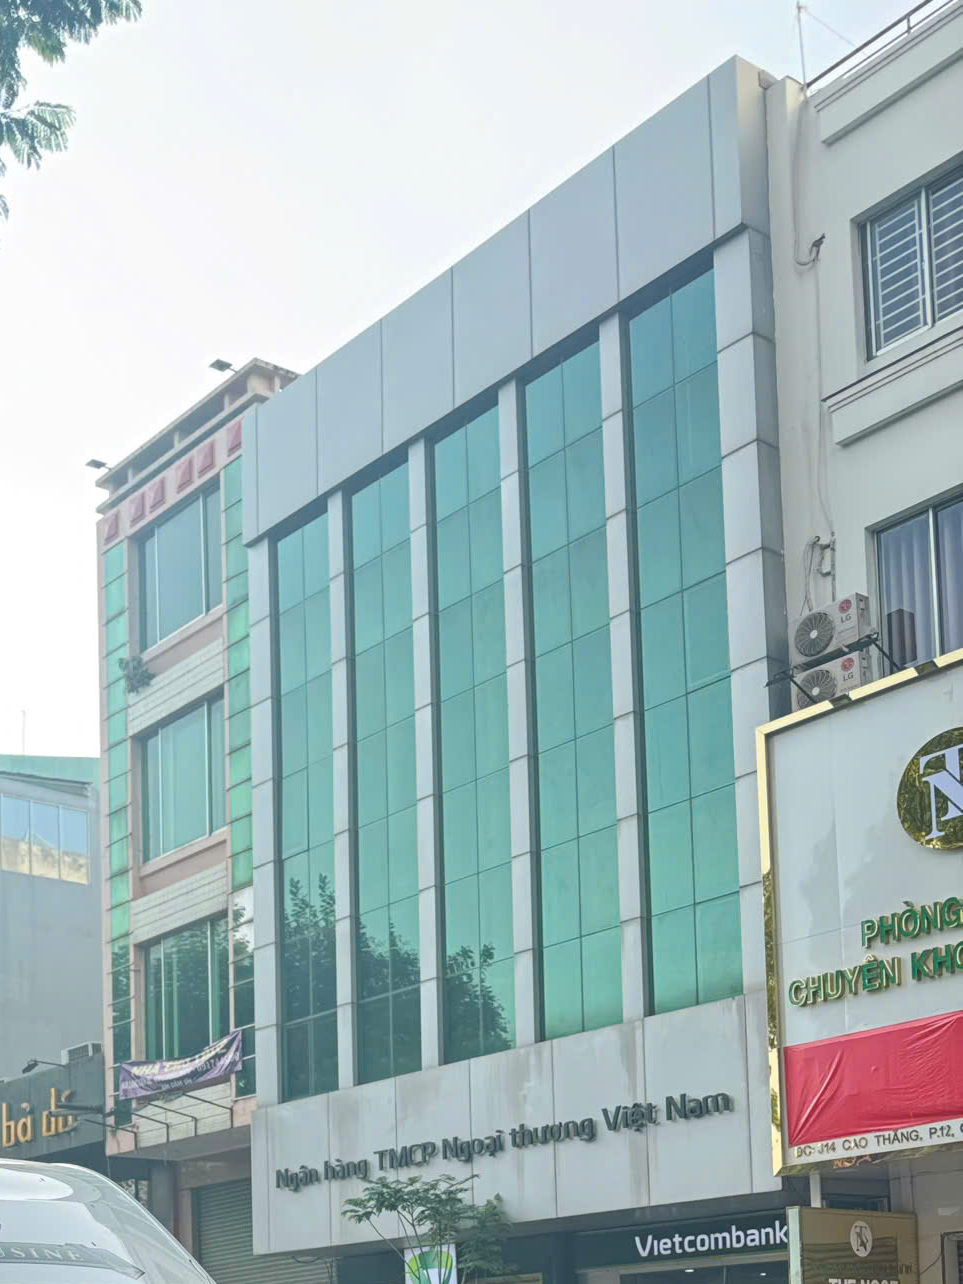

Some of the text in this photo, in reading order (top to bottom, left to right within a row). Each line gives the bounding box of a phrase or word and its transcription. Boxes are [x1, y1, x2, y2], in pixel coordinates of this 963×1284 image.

[841, 613, 852, 624] LG
[843, 671, 854, 682] LG
[861, 896, 963, 948] PHÒNG
[788, 953, 902, 1007] CHUYÊN
[276, 1092, 734, 1192] Ngân hàng TMCP Ngoại thương Việt Nam
[842, 1136, 869, 1151] CAO
[634, 1220, 789, 1257] Vietcombank
